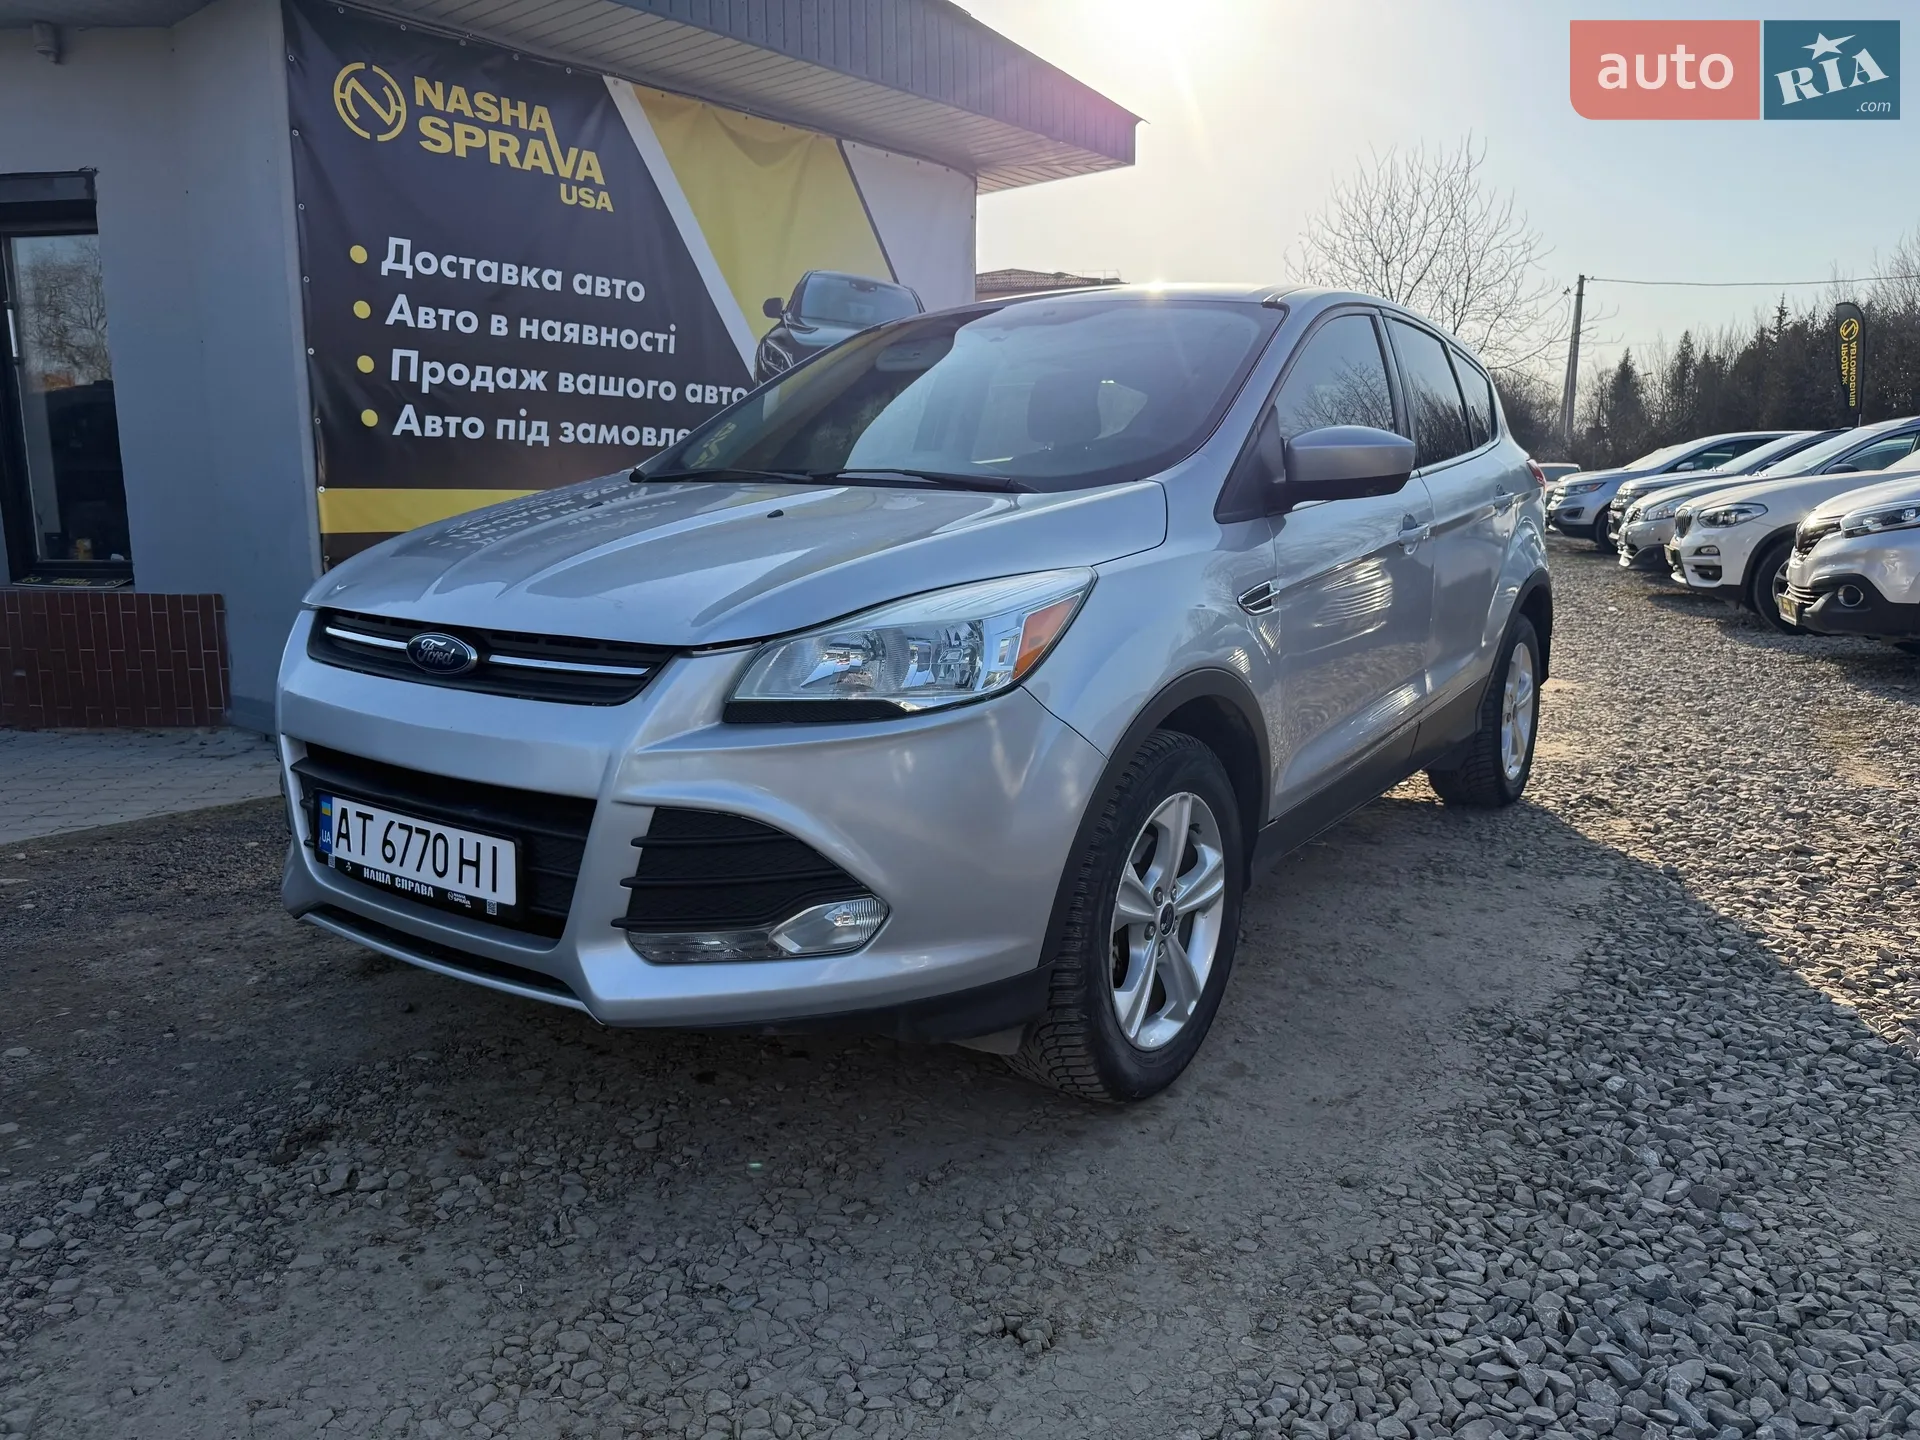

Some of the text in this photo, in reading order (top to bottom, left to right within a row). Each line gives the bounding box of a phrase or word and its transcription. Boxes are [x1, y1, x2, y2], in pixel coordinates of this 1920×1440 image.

[414, 76, 551, 132] NASHA
[418, 113, 605, 185] SPRAVA
[560, 183, 613, 212] USA
[380, 236, 645, 303] Доставка авто
[385, 294, 676, 355] Авто в наявності
[391, 348, 548, 394] Продаж
[558, 372, 677, 401] вашого
[392, 404, 485, 439] Авто
[496, 408, 550, 447] під
[417, 638, 455, 665] Ford
[321, 828, 331, 845] UA
[336, 807, 498, 893] AT 6770 HI
[363, 867, 434, 898] НАША СПРАВА
